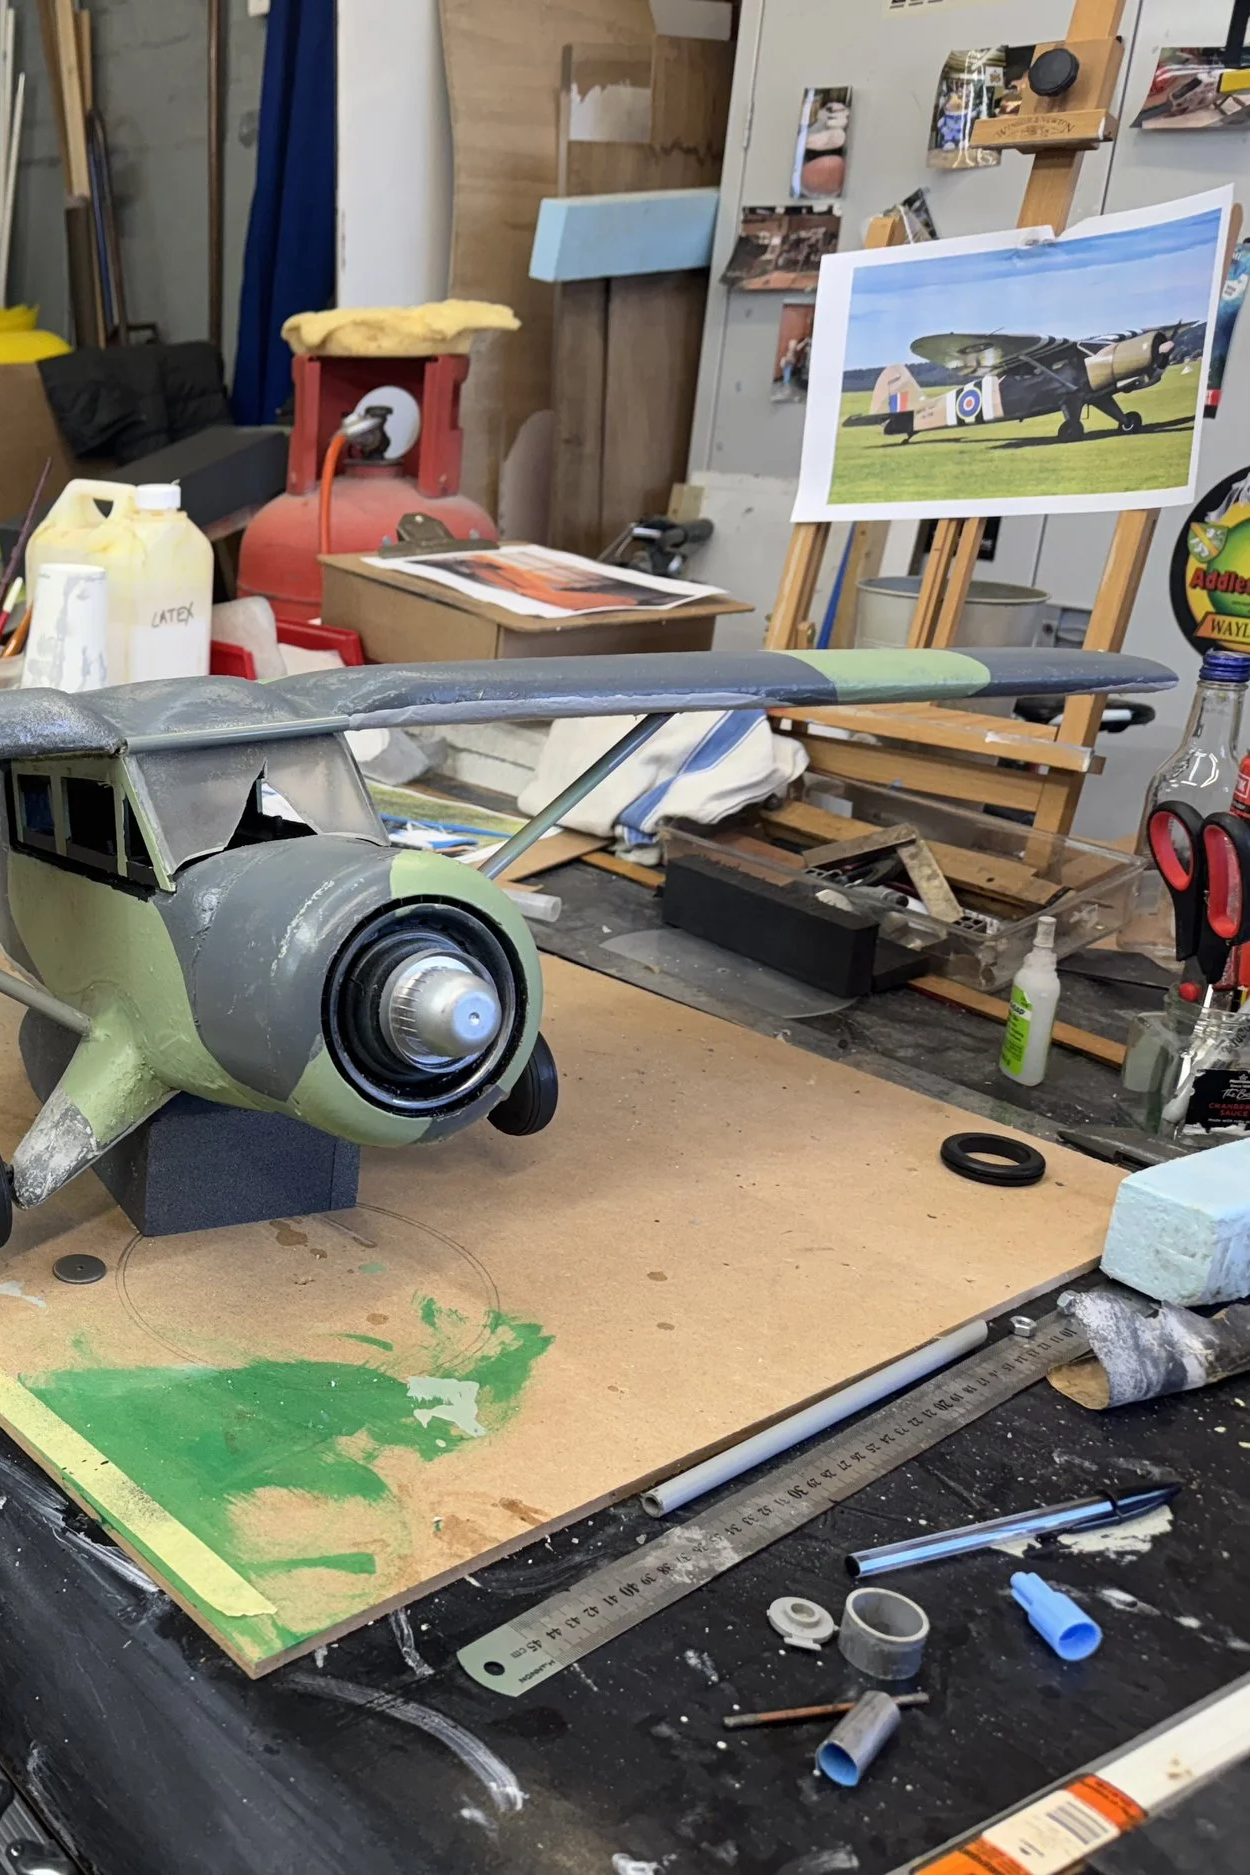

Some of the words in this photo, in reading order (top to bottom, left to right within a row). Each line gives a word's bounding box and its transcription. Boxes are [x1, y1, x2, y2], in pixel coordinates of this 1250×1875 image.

[150, 600, 194, 628] LATEX
[1059, 1327, 1078, 1339] 10
[1038, 1342, 1052, 1351] 12
[1001, 1363, 1016, 1372] 15
[976, 1377, 991, 1387] 17
[962, 1385, 978, 1395] 18
[949, 1393, 964, 1402] 19
[933, 1399, 954, 1412] 20
[921, 1409, 937, 1418] 21
[907, 1417, 923, 1427] 22
[879, 1434, 896, 1444] 24
[865, 1443, 881, 1453] 25
[849, 1452, 866, 1462] 26
[837, 1460, 852, 1471] 27
[806, 1478, 822, 1488] 29
[786, 1485, 809, 1499] 30
[757, 1505, 772, 1516] 32
[656, 1562, 674, 1575] 38
[640, 1573, 658, 1585] 39
[618, 1582, 640, 1597] 40
[602, 1595, 619, 1607] 41
[582, 1606, 600, 1618] 42
[564, 1616, 582, 1629] 43
[545, 1627, 563, 1640] 44
[525, 1639, 543, 1653] 45
[510, 1646, 528, 1660] cm
